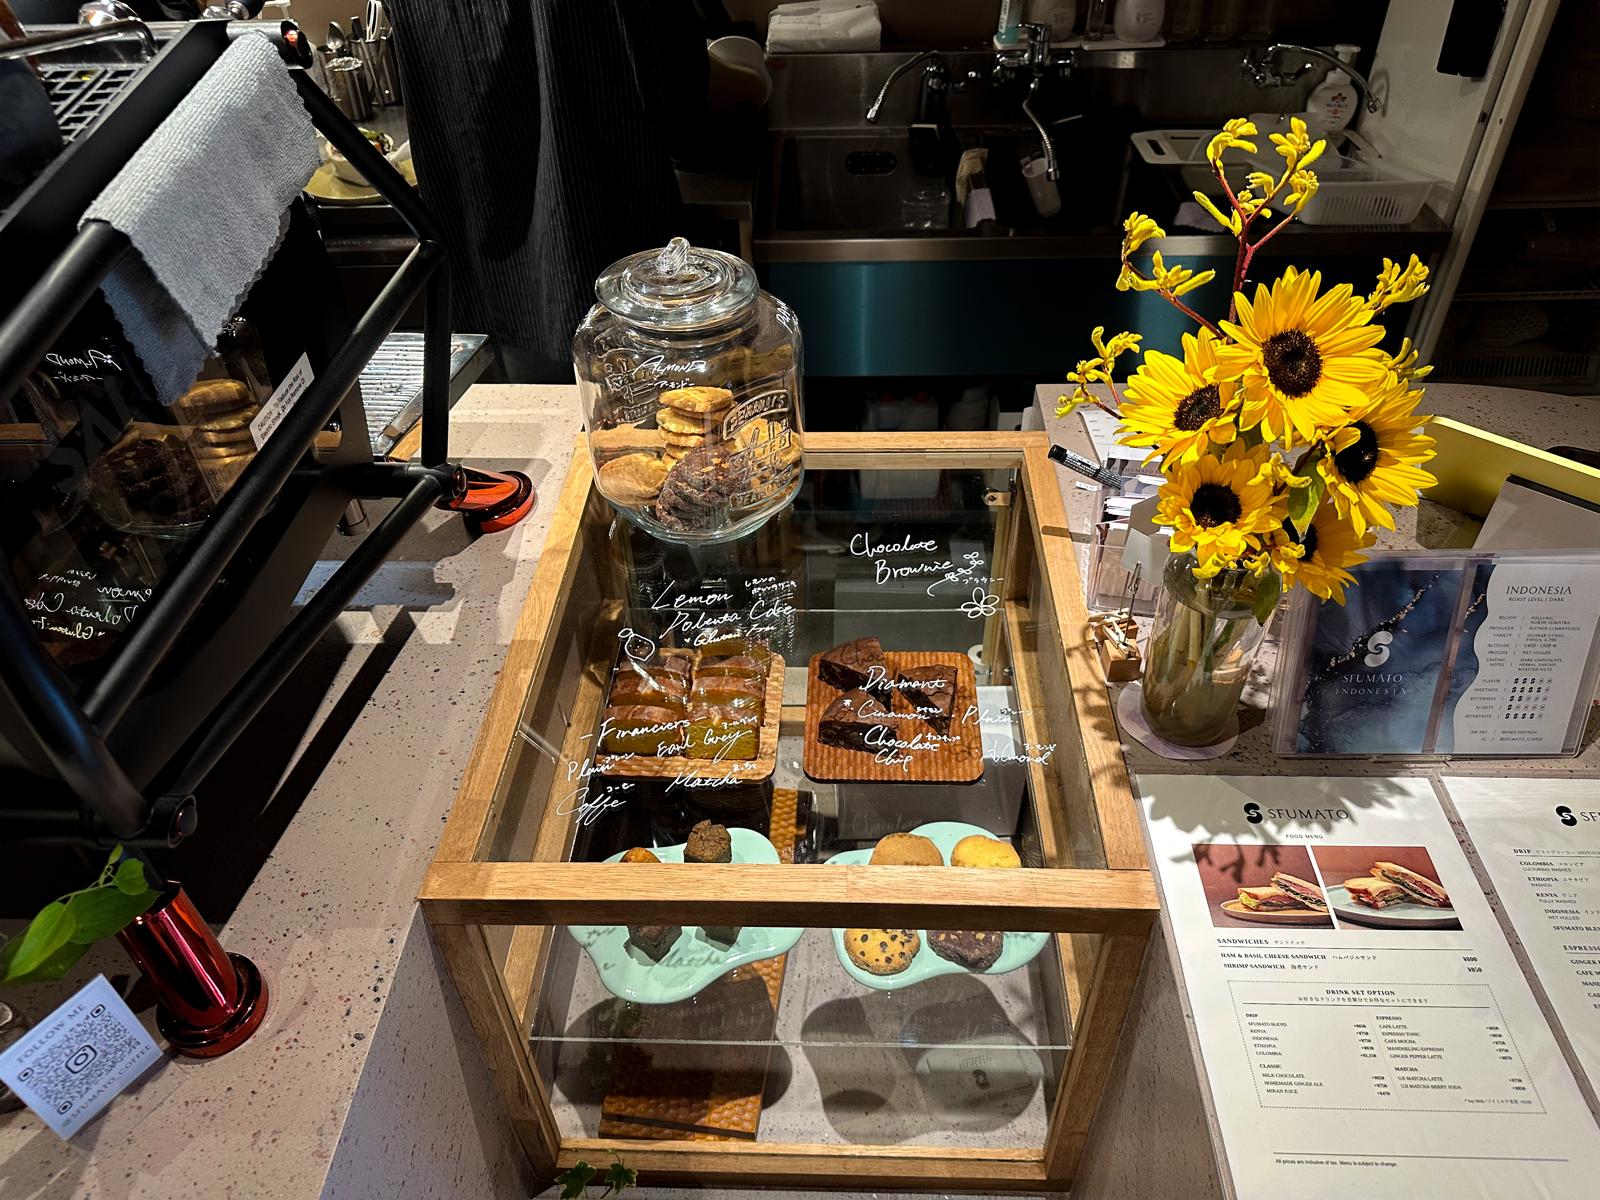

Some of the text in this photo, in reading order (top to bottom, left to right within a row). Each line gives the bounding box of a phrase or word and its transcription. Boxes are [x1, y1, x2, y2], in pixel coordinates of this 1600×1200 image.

[632, 354, 707, 374] ALMOND
[850, 531, 938, 557] Chocolate
[874, 559, 954, 585] Brownie
[651, 580, 734, 610] Lemon
[1506, 585, 1572, 595] INDONESIA
[859, 665, 948, 692] Diamant
[1341, 673, 1404, 684] SFUMATO
[1335, 687, 1407, 696] INDONESIA
[864, 724, 940, 751] Chocolate
[874, 748, 914, 773] Chip
[665, 770, 743, 793] Matcha
[1267, 808, 1349, 820] SFUMATO
[1580, 811, 1600, 822] SF
[1216, 937, 1269, 945] SANDWICHES
[16, 1002, 87, 1064] FOLLOW ME
